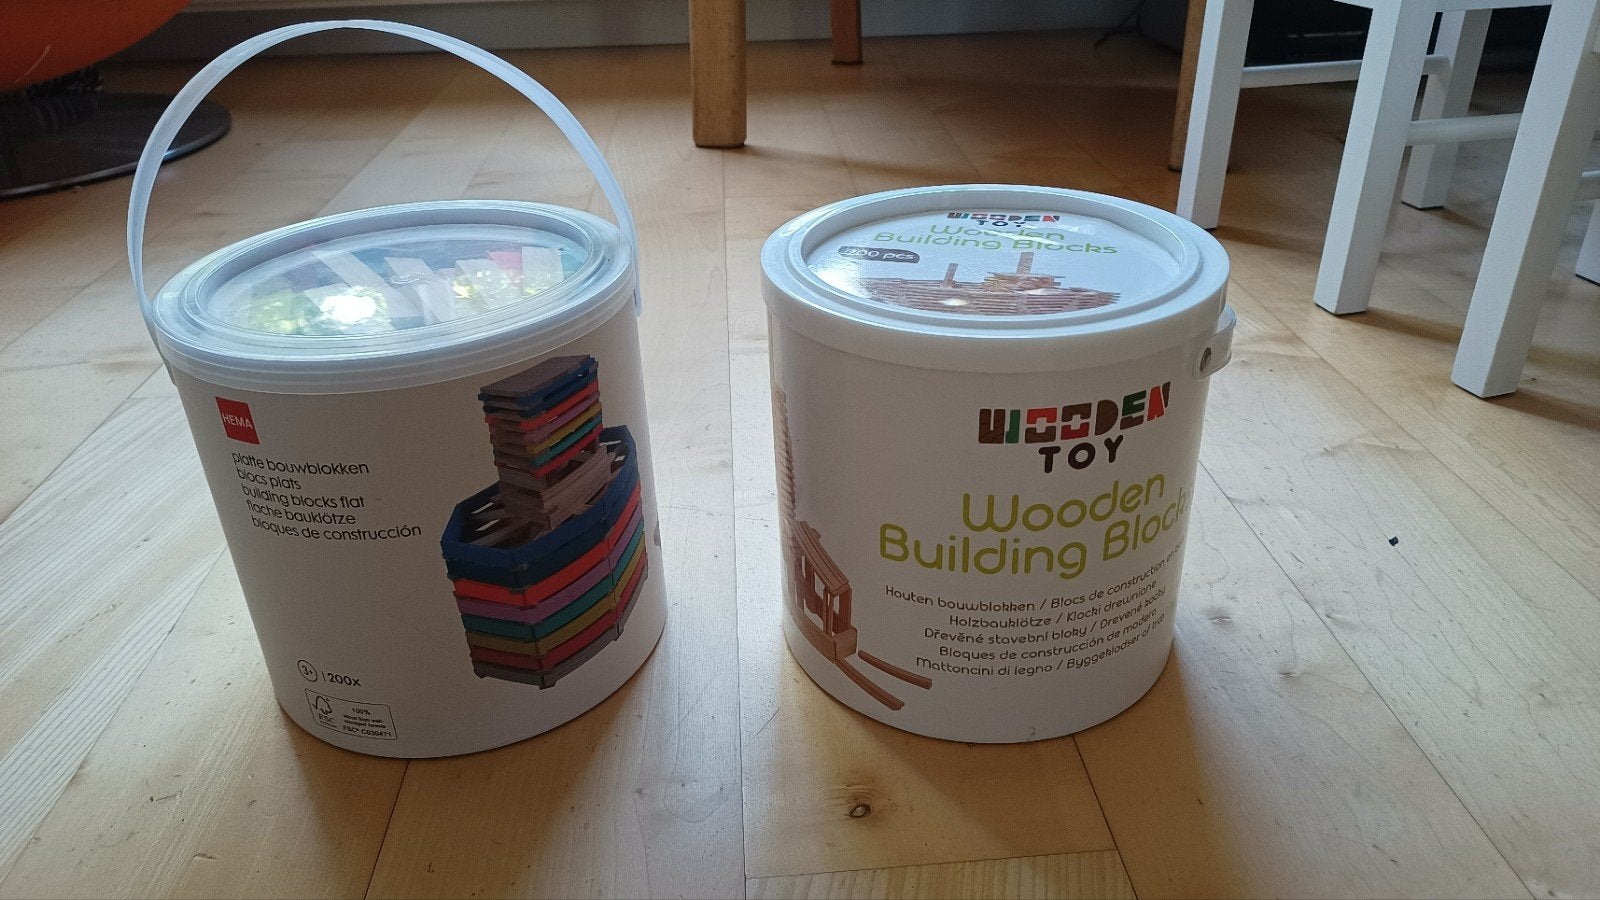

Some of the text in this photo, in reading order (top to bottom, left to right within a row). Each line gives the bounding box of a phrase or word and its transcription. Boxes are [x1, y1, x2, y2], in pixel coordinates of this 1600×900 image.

[947, 212, 1060, 222] WOODEN
[976, 220, 1026, 228] TOY
[873, 231, 1118, 254] Building Blocks
[882, 252, 914, 260] pcs
[221, 412, 254, 430] HEMA
[978, 381, 1171, 444] WOODEN
[232, 452, 369, 475] platte bouwblokken
[1038, 434, 1124, 474] TOY
[236, 466, 302, 490] blocs plats
[241, 483, 365, 509] building blocks flat
[962, 474, 1165, 533] Wooden
[246, 499, 357, 525] flache bauklötze
[251, 514, 422, 541] bloques de construcción
[879, 484, 1194, 580] Building Block
[885, 585, 934, 606] Houten
[937, 597, 1035, 612] bouwblokken
[1050, 594, 1086, 609] Blocs
[1088, 589, 1104, 601] de
[1107, 559, 1165, 596] construction
[924, 627, 984, 645] Dřevěné
[988, 630, 1049, 645] stavební
[1051, 626, 1087, 641] bloky
[1100, 604, 1142, 630] Drevené
[949, 615, 1052, 629] Holzbauklötze
[1066, 605, 1101, 623] Klocki
[939, 646, 995, 661] Bloques
[999, 650, 1017, 660] de
[1021, 636, 1104, 660] construcción
[1107, 630, 1121, 642] de
[301, 665, 362, 687] 3+ 200x
[916, 657, 994, 676] Mattoncini
[997, 666, 1011, 676] di
[1014, 664, 1053, 677] legno
